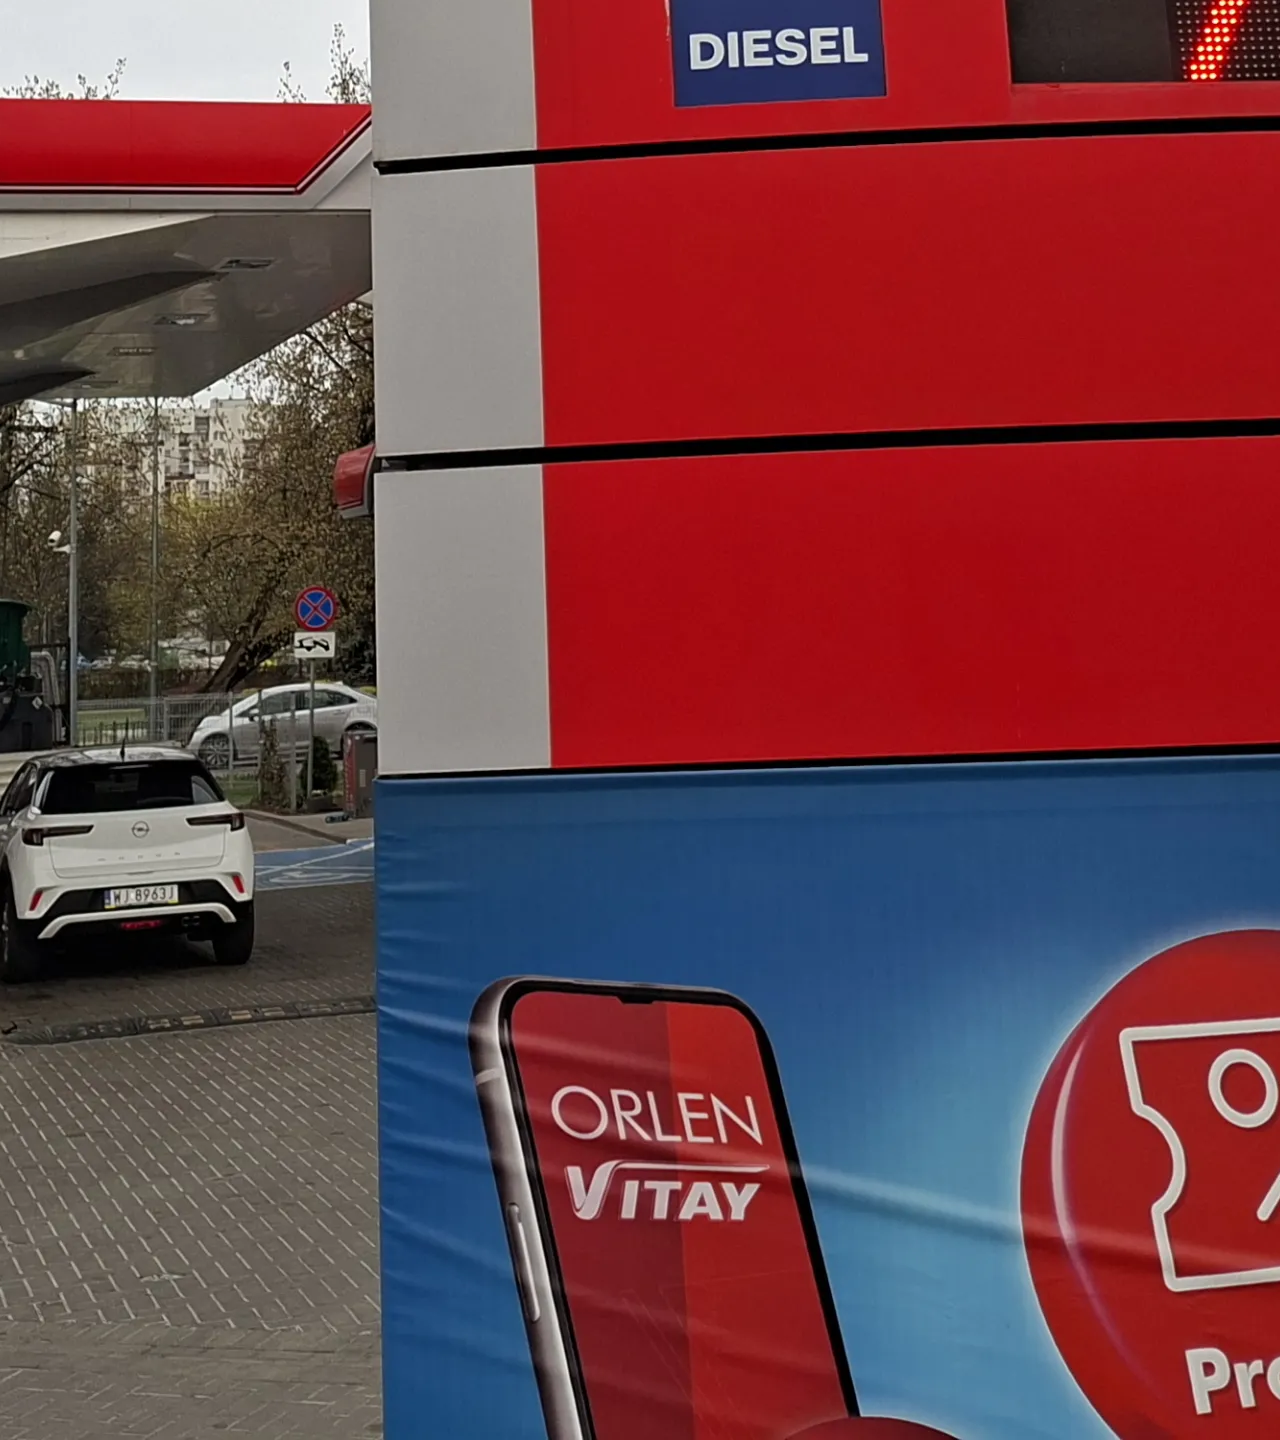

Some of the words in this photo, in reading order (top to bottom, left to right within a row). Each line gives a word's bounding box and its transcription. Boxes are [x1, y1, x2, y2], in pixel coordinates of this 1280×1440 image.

[689, 26, 869, 71] DIESEL
[135, 887, 174, 902] 8963J
[550, 1085, 764, 1146] ORLEN
